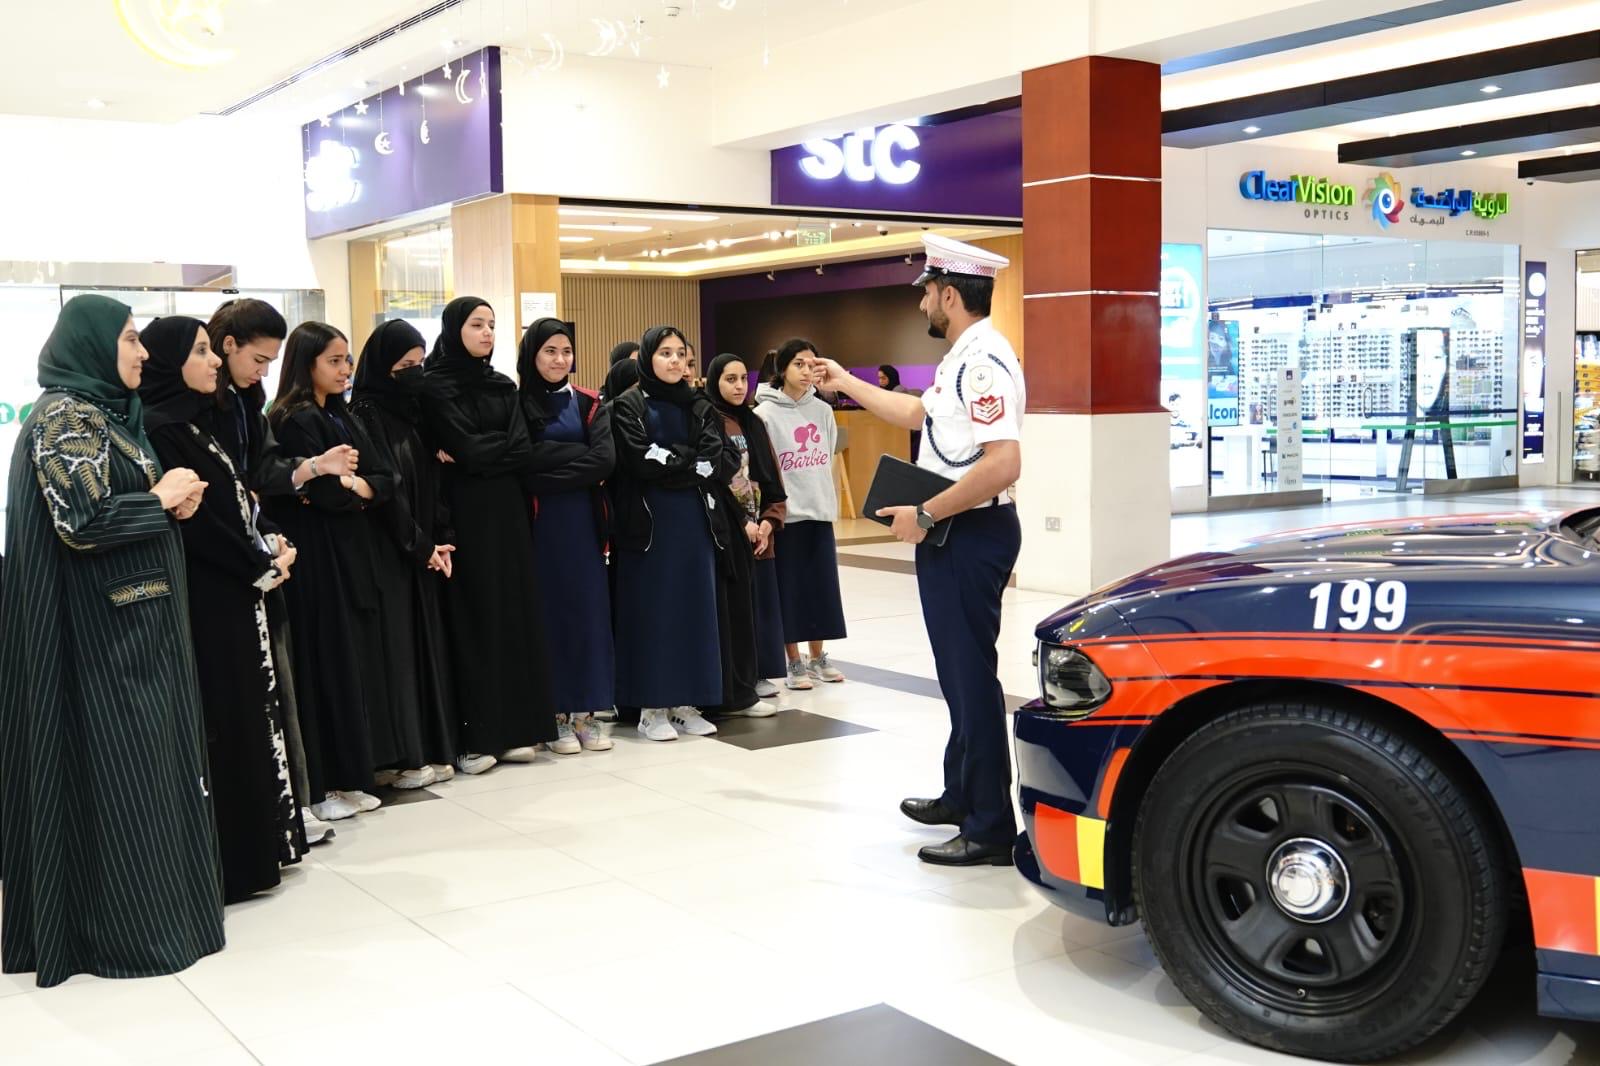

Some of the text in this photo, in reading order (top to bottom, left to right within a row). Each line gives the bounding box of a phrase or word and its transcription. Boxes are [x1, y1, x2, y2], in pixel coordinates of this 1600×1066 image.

[798, 123, 921, 185] stc
[1303, 208, 1350, 221] OPTICS
[778, 448, 829, 471] Barbie
[1309, 579, 1408, 631] 199
